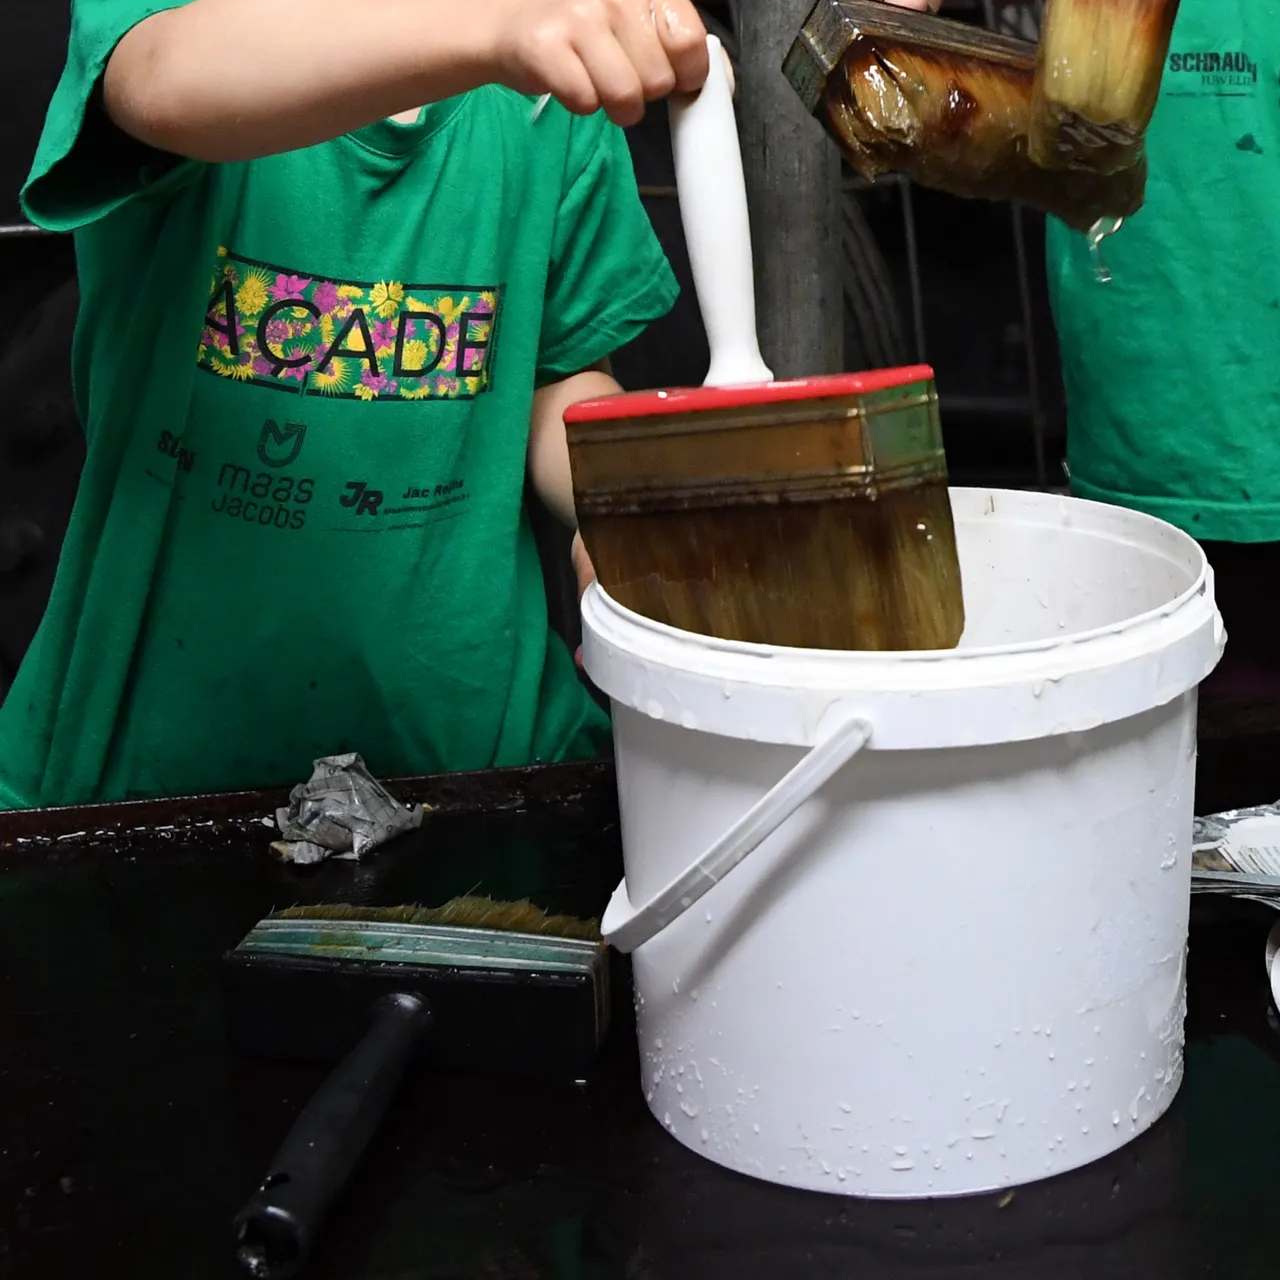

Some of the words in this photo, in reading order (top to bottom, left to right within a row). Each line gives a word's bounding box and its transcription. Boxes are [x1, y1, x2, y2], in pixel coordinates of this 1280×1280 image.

[217, 461, 316, 506] maas
[339, 480, 384, 516] JR
[210, 492, 308, 531] Jacobs
